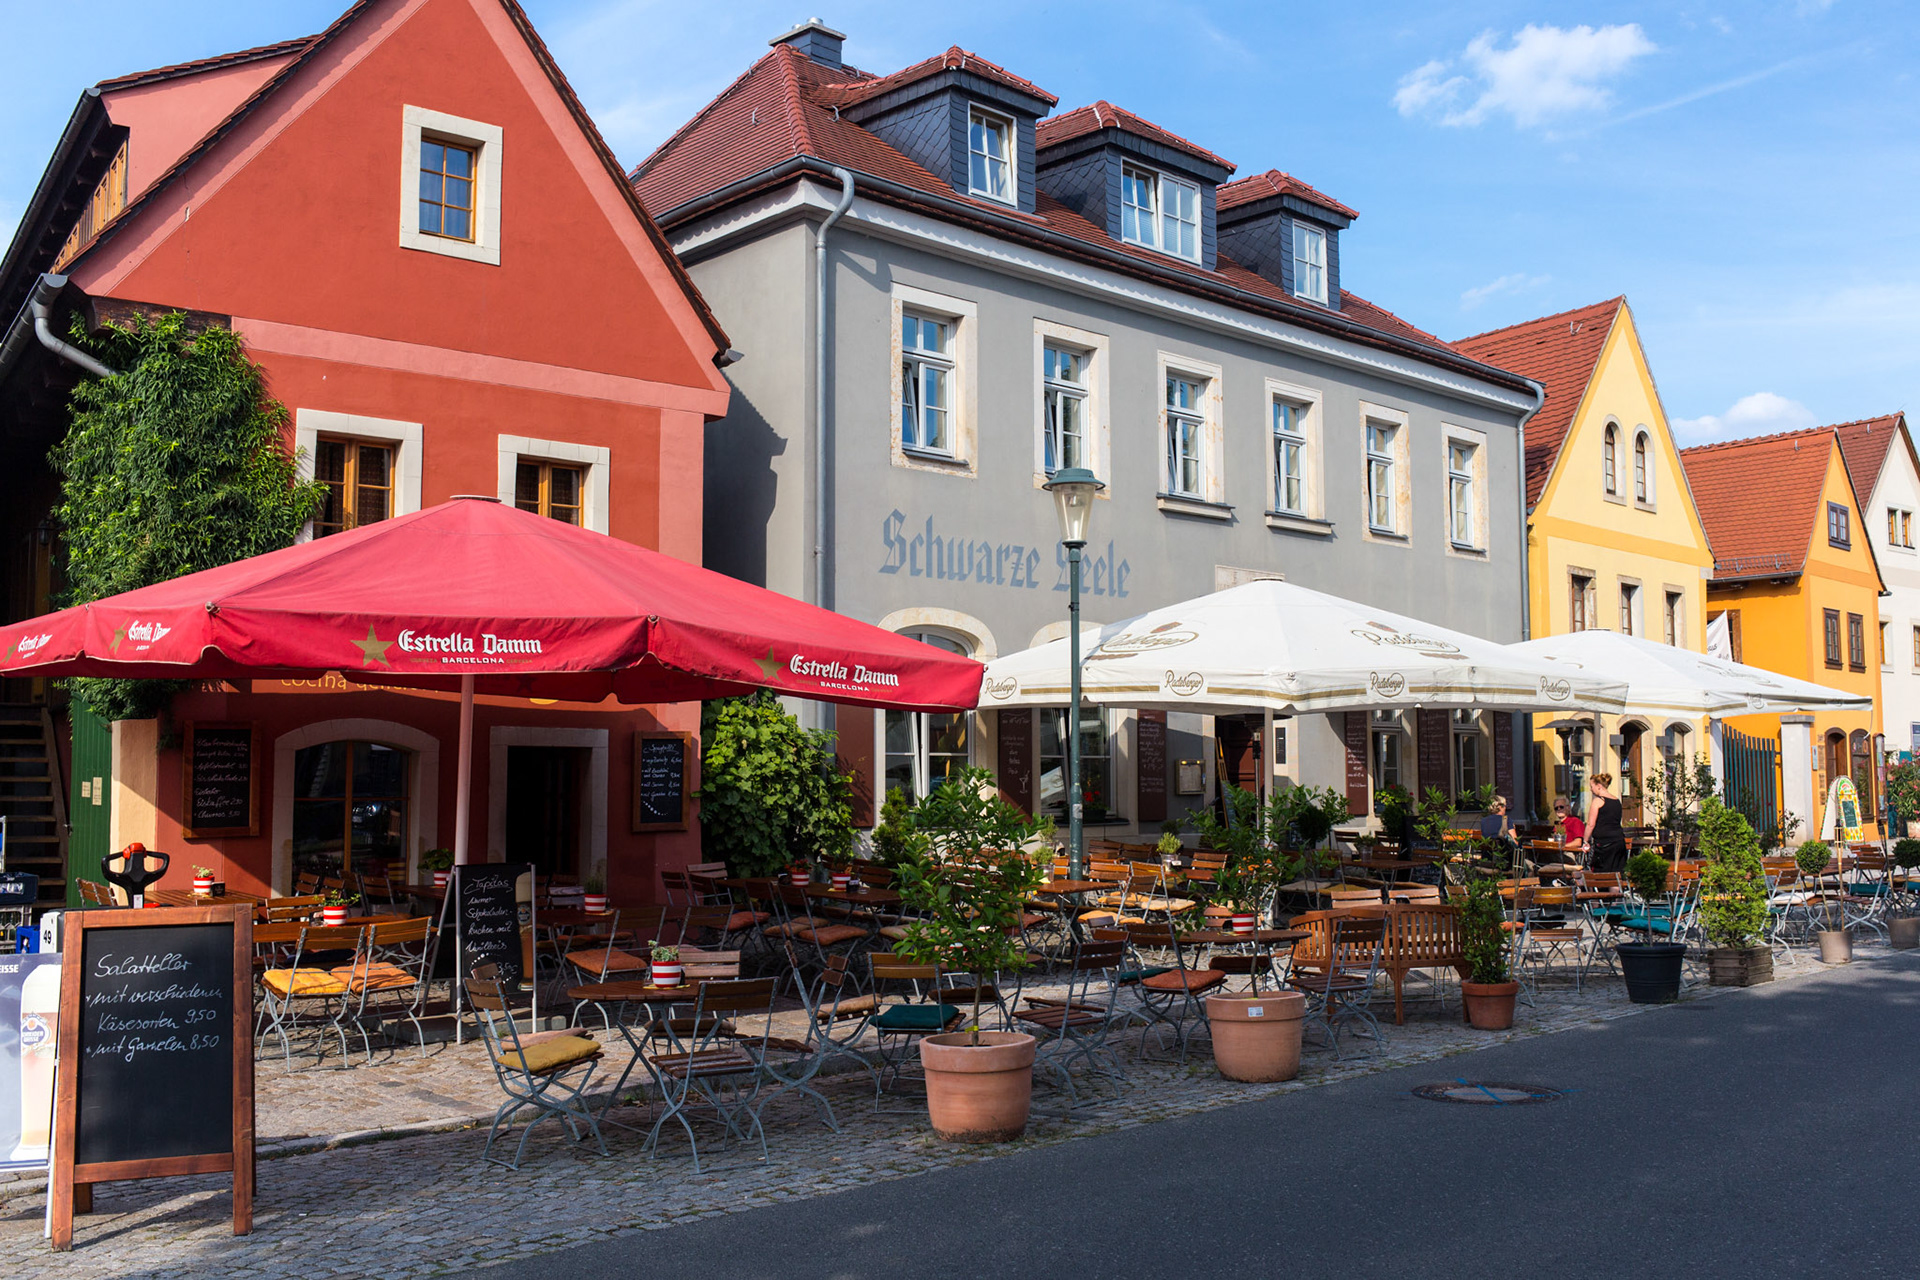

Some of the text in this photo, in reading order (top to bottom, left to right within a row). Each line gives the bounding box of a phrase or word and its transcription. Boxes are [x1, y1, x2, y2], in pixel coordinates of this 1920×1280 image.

[878, 508, 1131, 598] Schwarze Seele
[397, 629, 543, 655] Estrella Damm
[790, 654, 899, 687] Estrella Damm
[820, 681, 870, 692] BARCELONA
[472, 874, 509, 893] Tapitas
[43, 929, 52, 945] 49
[94, 952, 192, 978] Salatteller
[90, 984, 129, 1008] mit
[97, 1009, 217, 1034] Käsesorten 9,50
[91, 1034, 220, 1063] mit Garnelen 8,50
